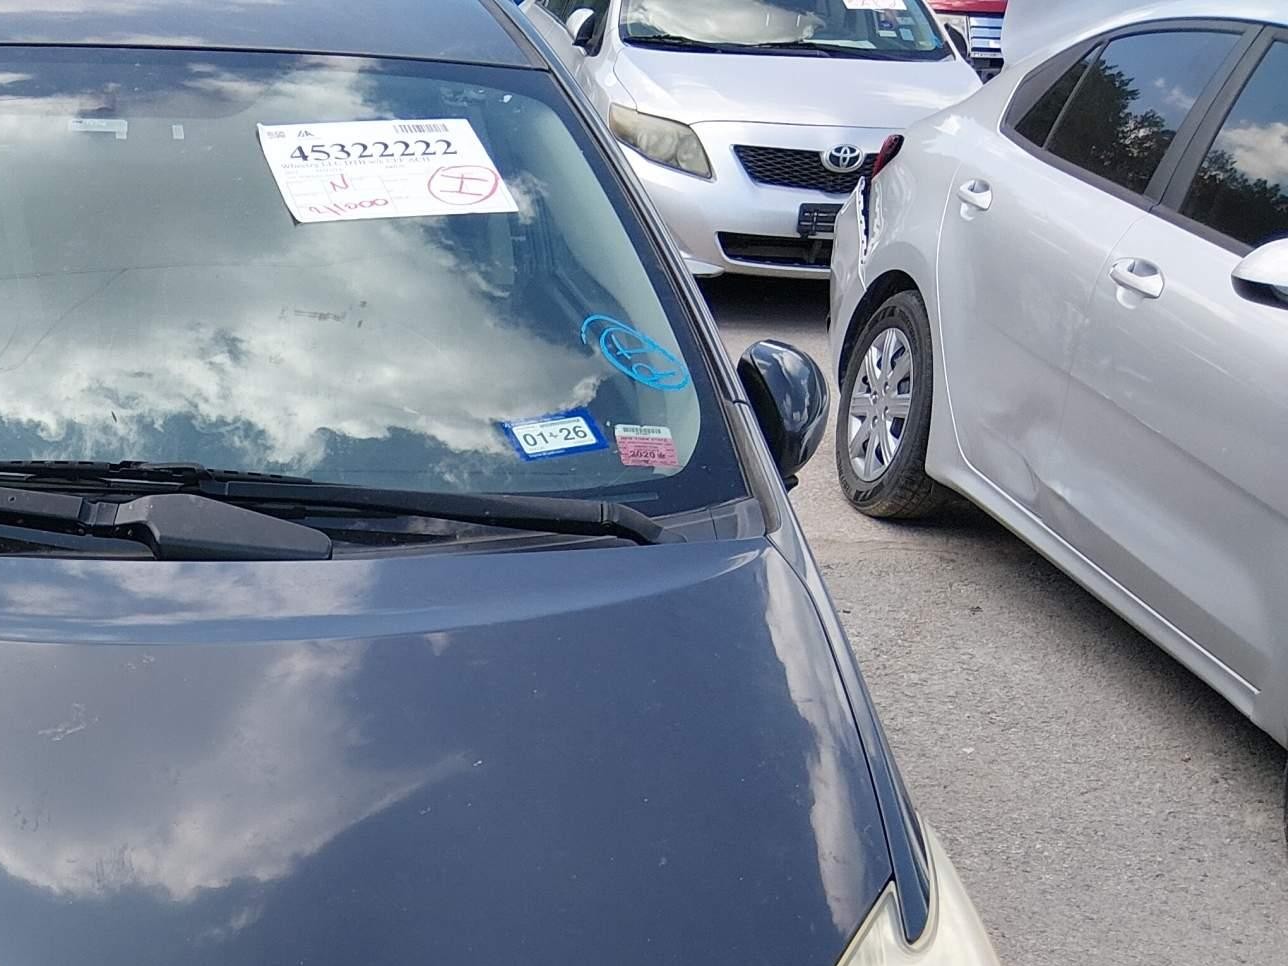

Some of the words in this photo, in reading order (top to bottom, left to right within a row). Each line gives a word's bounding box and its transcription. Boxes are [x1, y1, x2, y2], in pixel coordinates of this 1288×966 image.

[289, 139, 458, 161] 45322222
[522, 432, 549, 447] 01
[558, 425, 588, 441] 26
